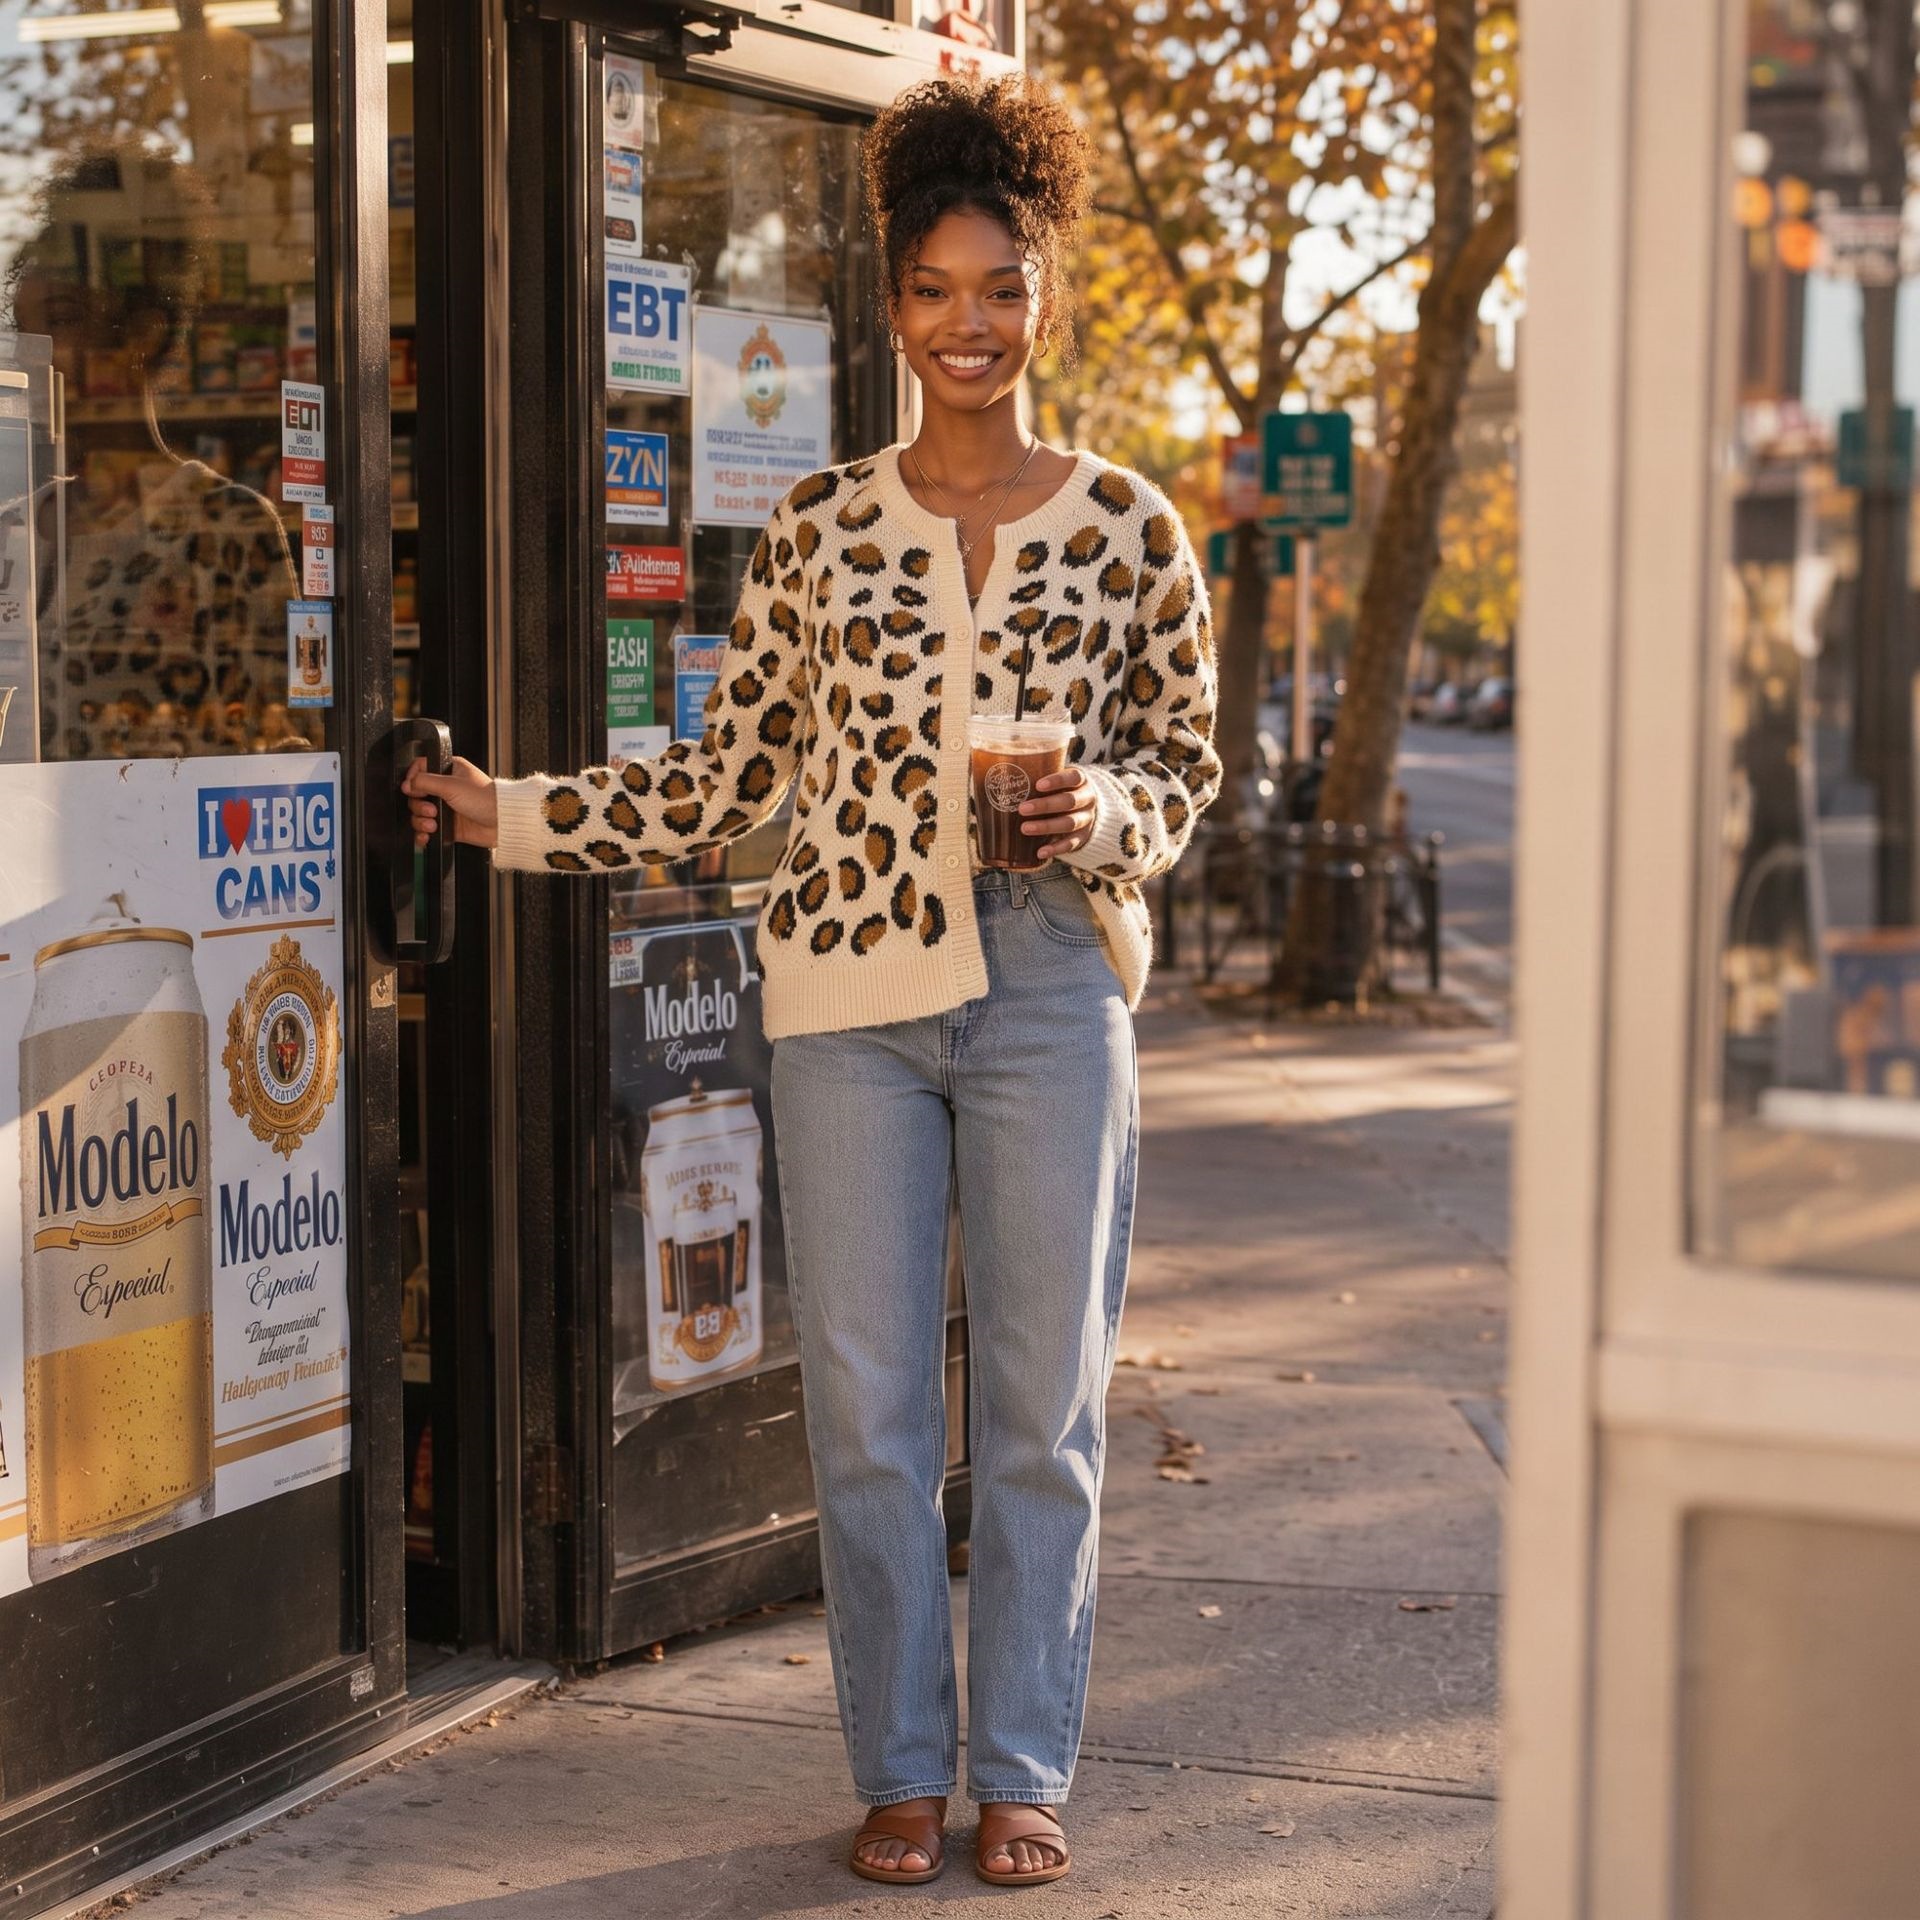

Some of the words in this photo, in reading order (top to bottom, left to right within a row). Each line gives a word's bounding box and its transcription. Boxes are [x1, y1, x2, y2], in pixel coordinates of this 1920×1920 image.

[608, 279, 686, 342] EBT
[644, 978, 737, 1042] Modelo
[37, 1093, 199, 1218] Modelo
